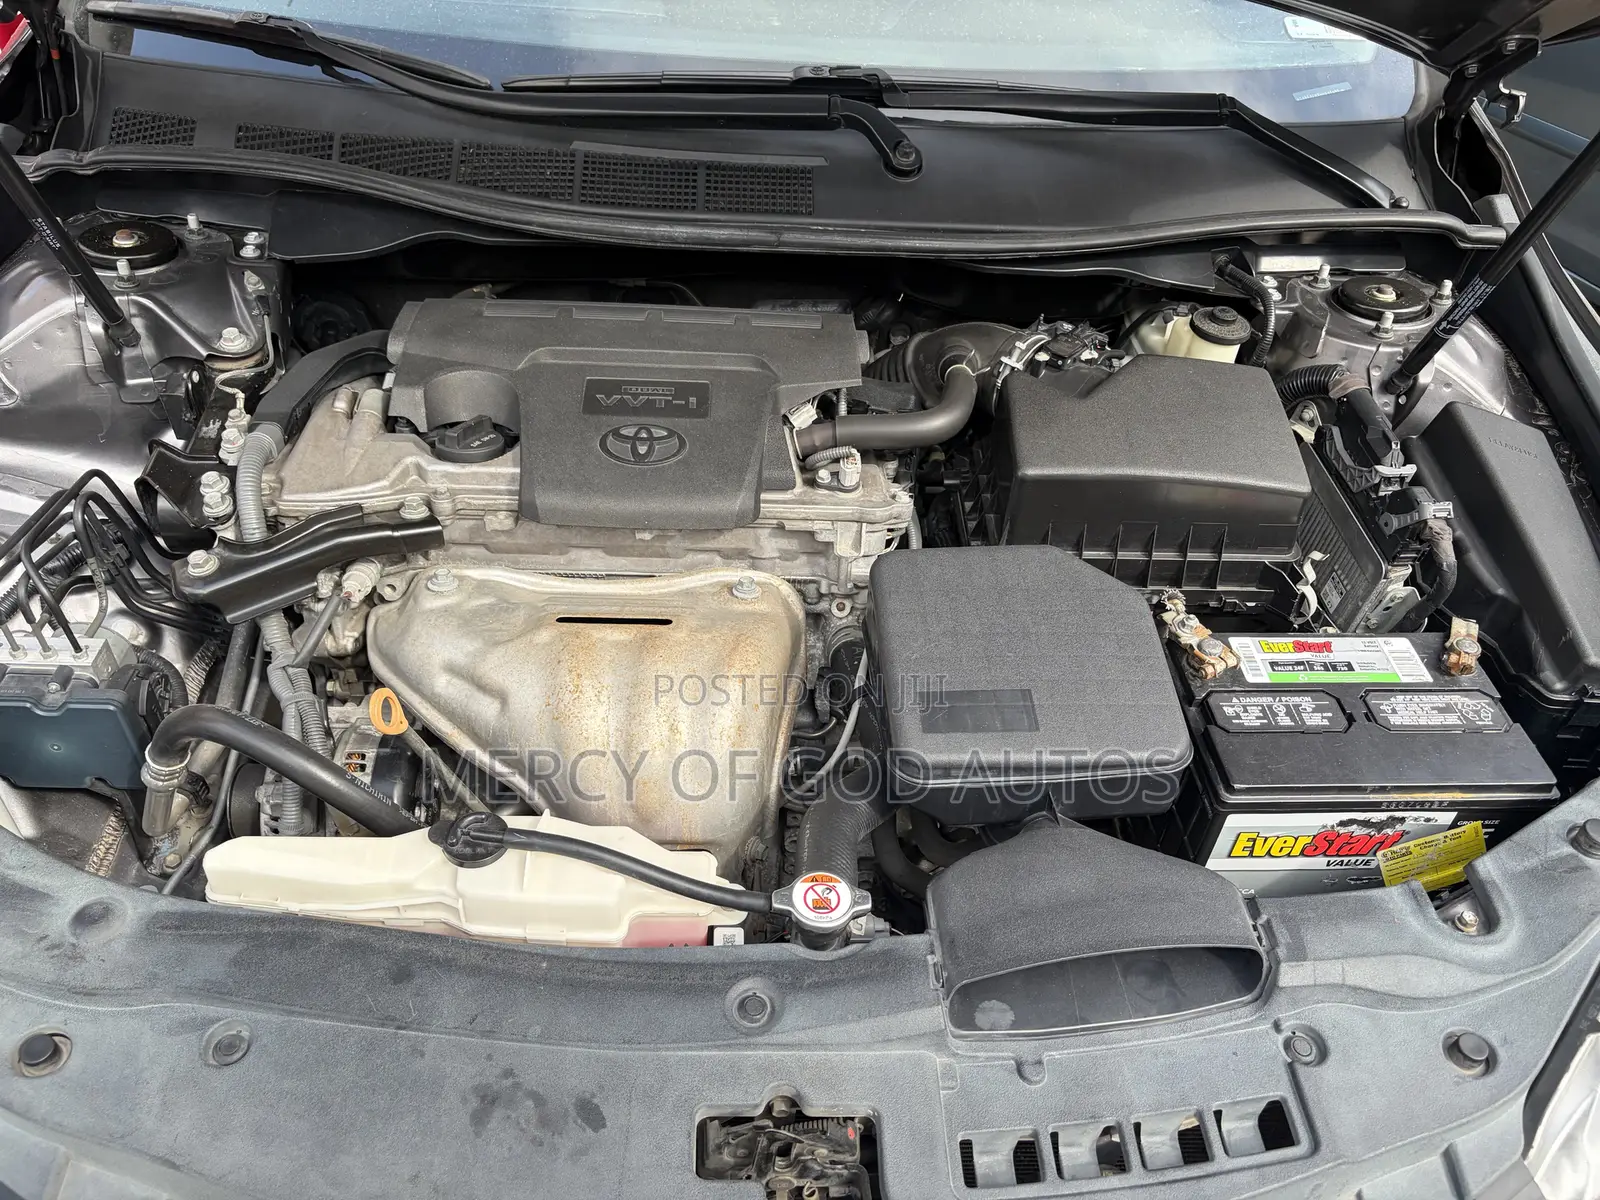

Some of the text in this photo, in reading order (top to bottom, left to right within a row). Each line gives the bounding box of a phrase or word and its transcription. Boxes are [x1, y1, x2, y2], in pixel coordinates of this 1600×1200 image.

[1259, 640, 1333, 654] EverStart
[1228, 830, 1406, 858] EverStart
[1325, 858, 1376, 867] VALUE
